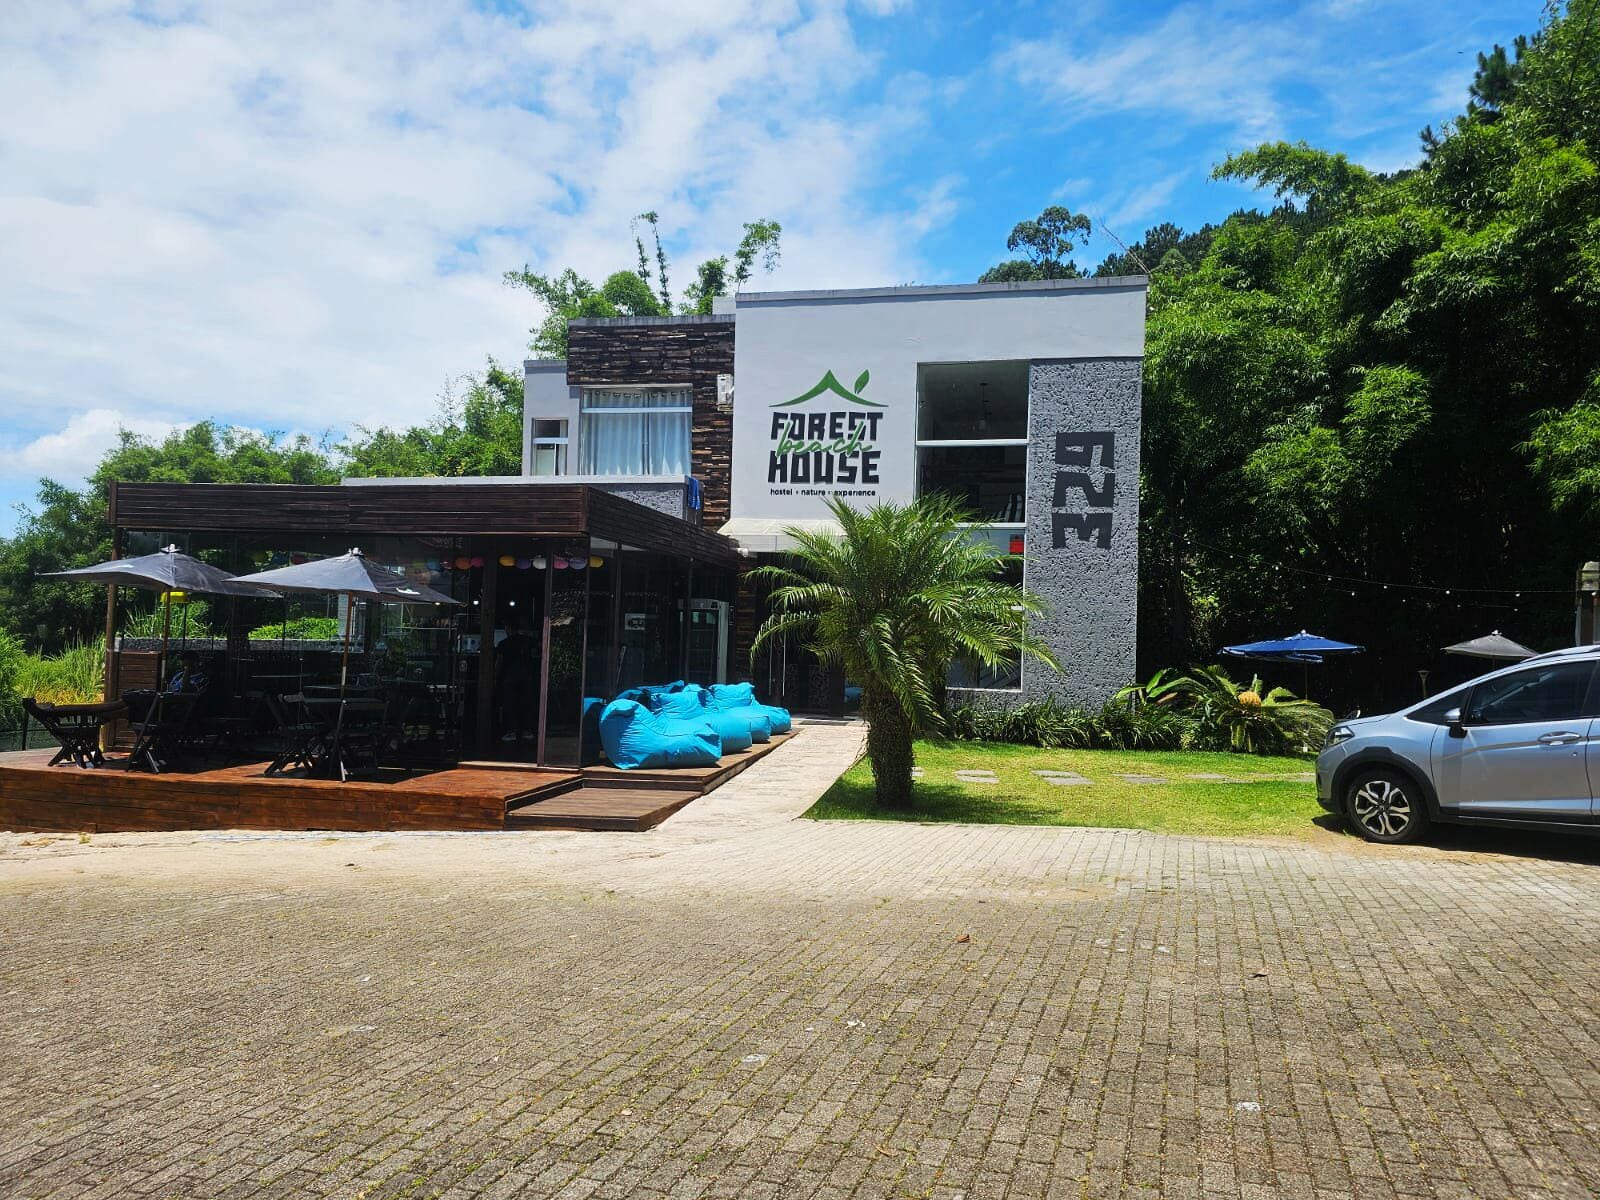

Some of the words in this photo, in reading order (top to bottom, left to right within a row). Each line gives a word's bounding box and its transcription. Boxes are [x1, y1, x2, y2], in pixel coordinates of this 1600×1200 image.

[770, 411, 884, 441] FOREST
[775, 420, 873, 457] beach
[767, 450, 882, 485] HOUSE
[770, 488, 793, 496] hostel
[834, 489, 876, 498] experience
